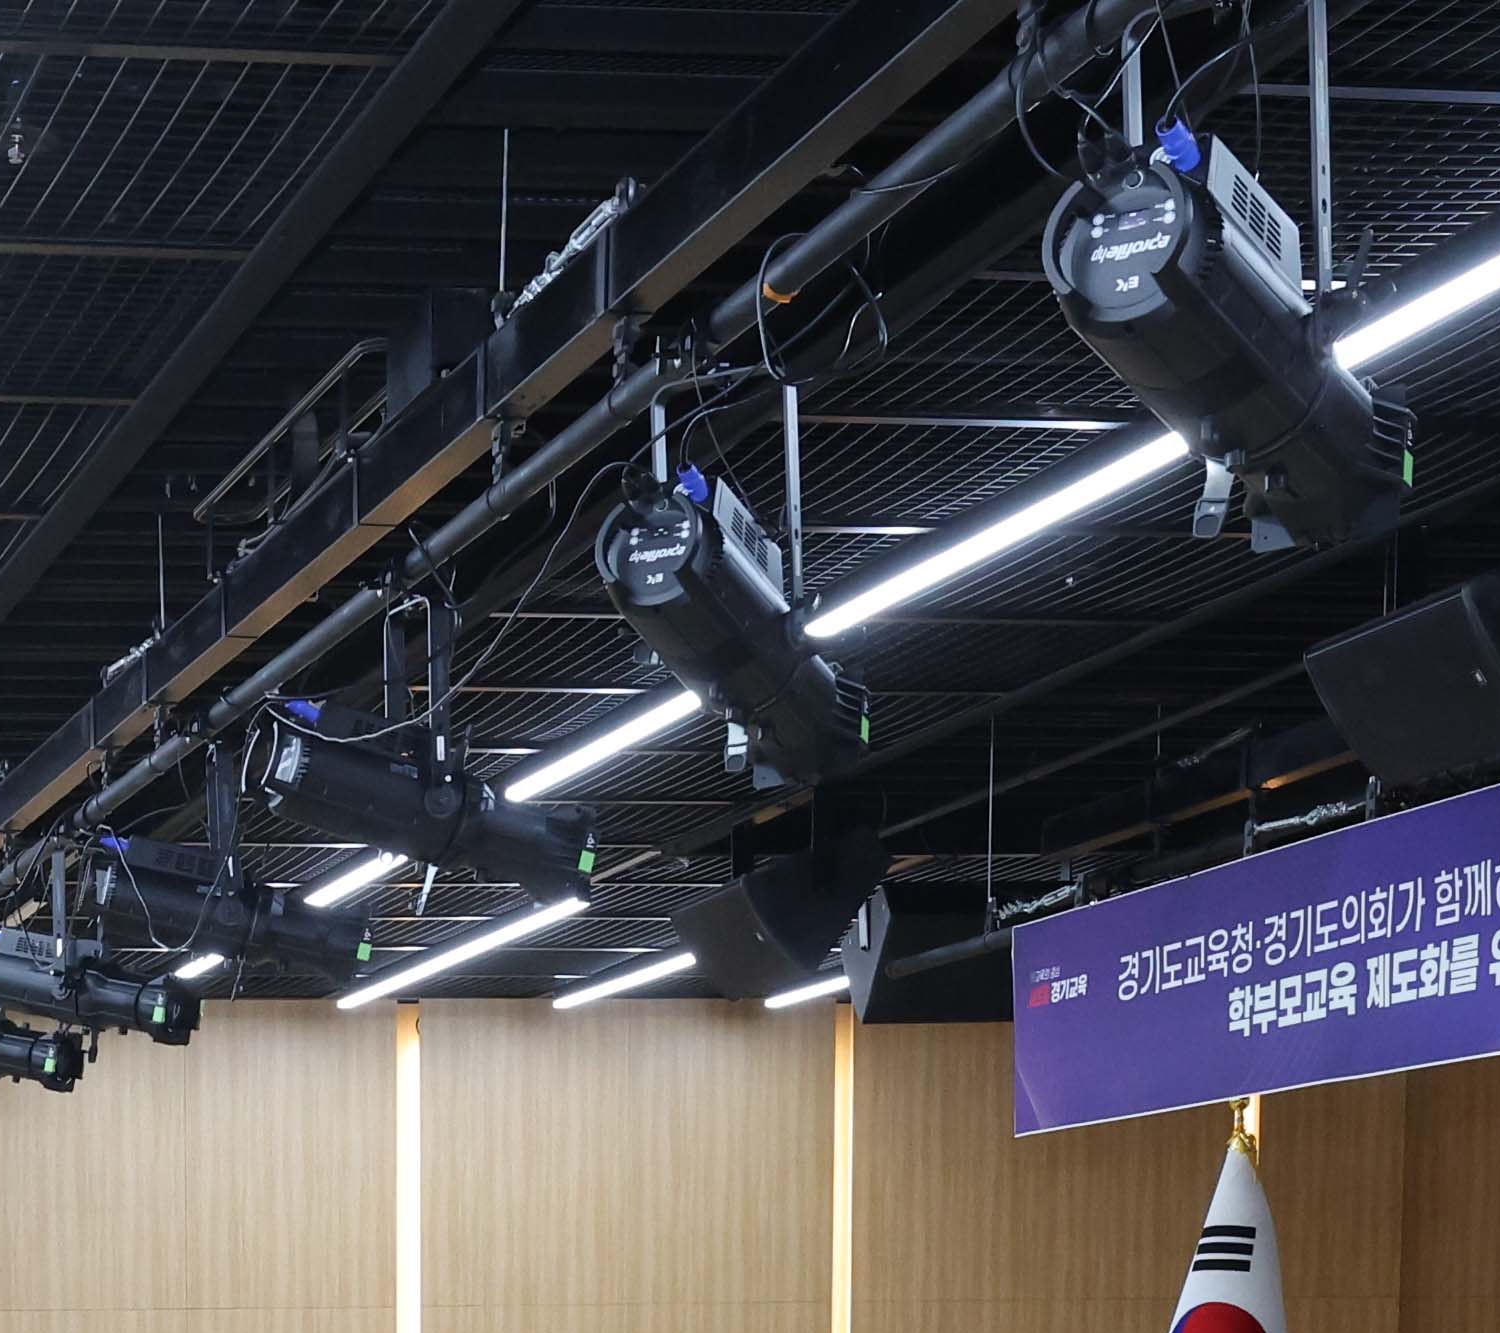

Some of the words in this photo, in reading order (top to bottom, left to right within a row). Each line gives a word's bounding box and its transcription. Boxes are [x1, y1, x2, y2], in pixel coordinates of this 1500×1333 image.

[1051, 974, 1087, 1003] 경기교육
[1228, 962, 1358, 1037] 학부모교육
[1366, 933, 1480, 1009] 제도화를
